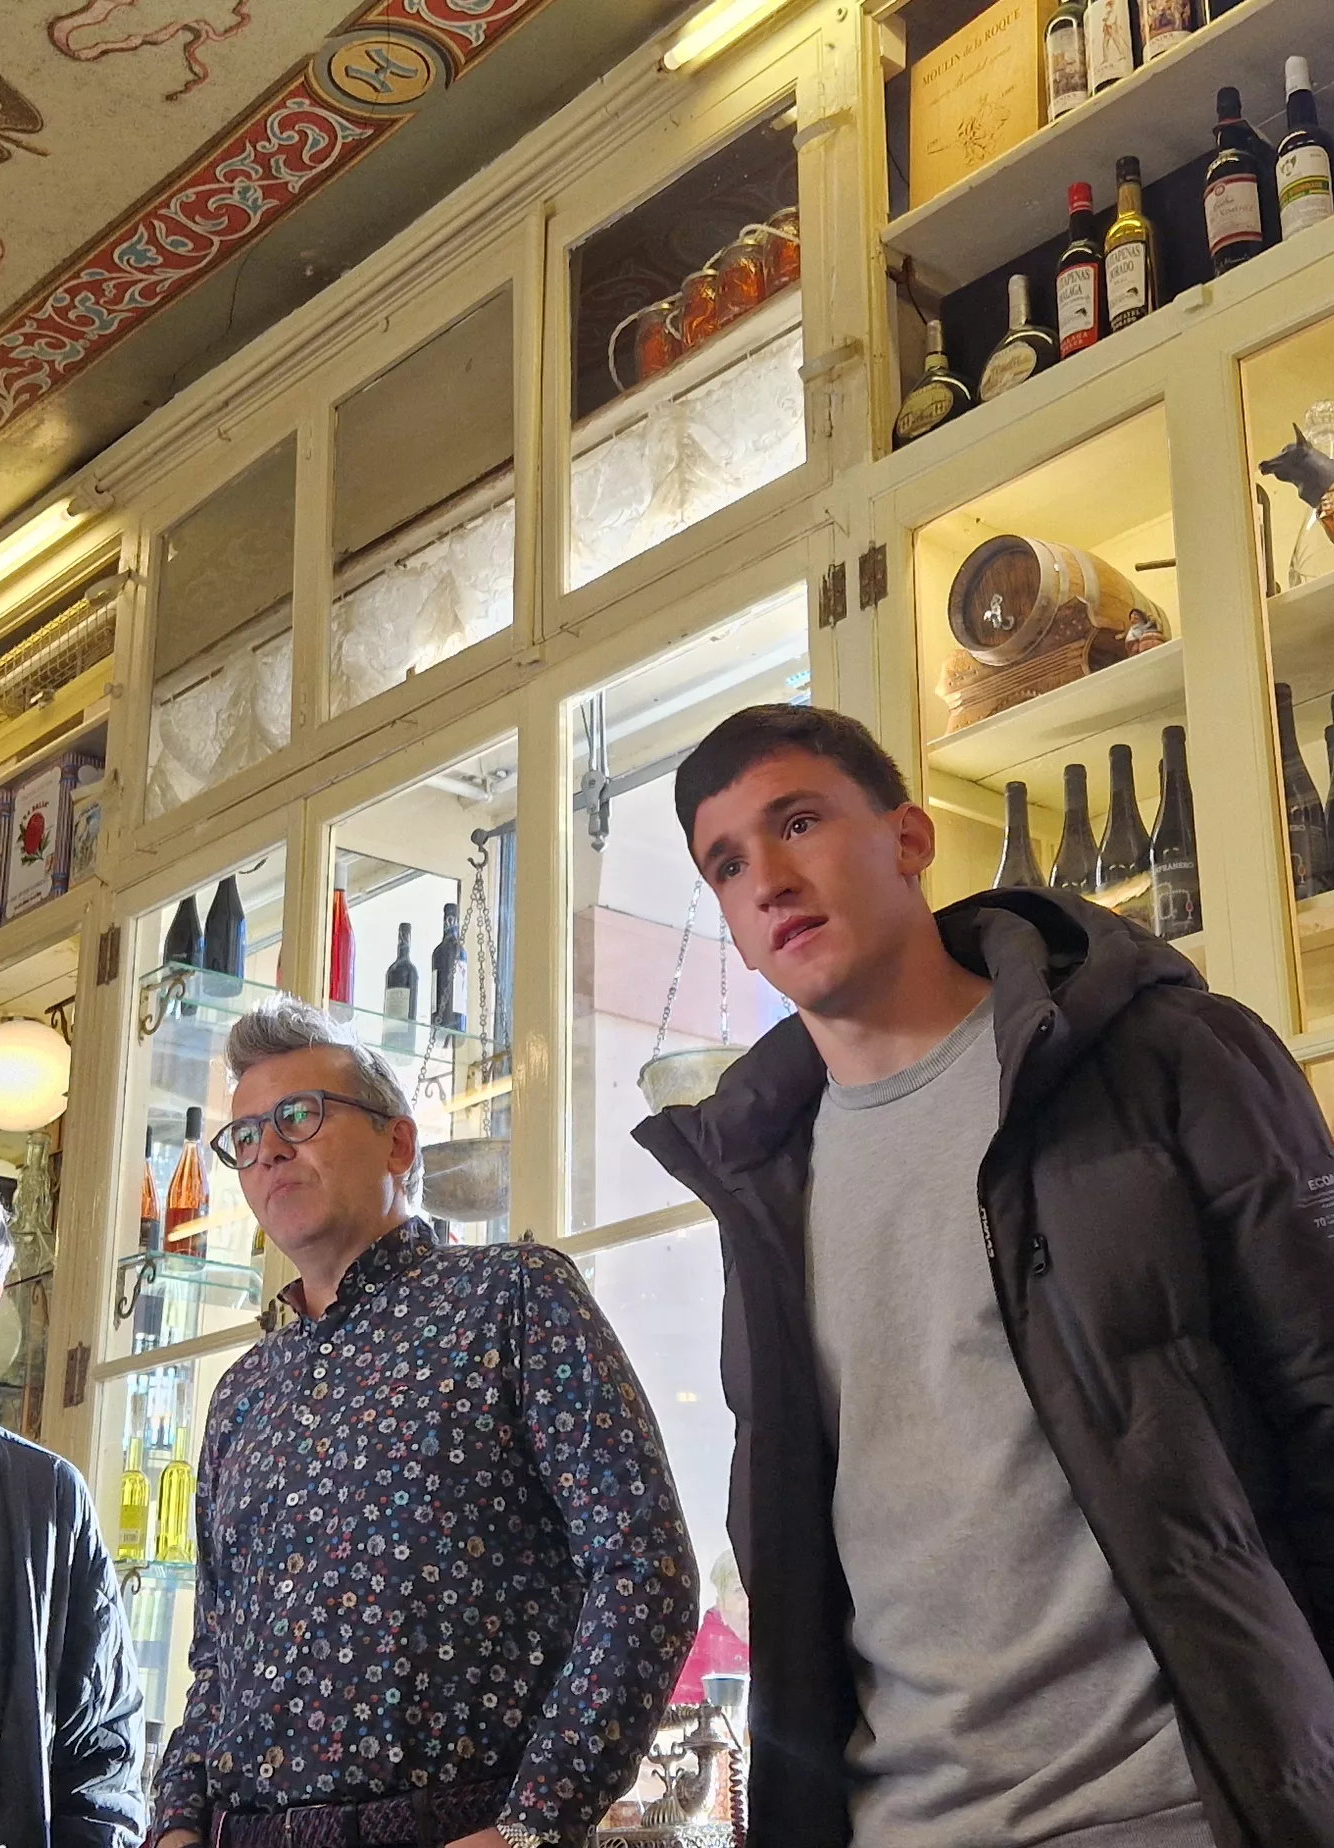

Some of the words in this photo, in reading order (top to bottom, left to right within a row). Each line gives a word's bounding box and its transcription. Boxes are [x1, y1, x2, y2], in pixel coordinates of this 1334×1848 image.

[922, 50, 962, 87] MOULIN
[962, 42, 973, 57] de
[984, 7, 1021, 42] ROQUE
